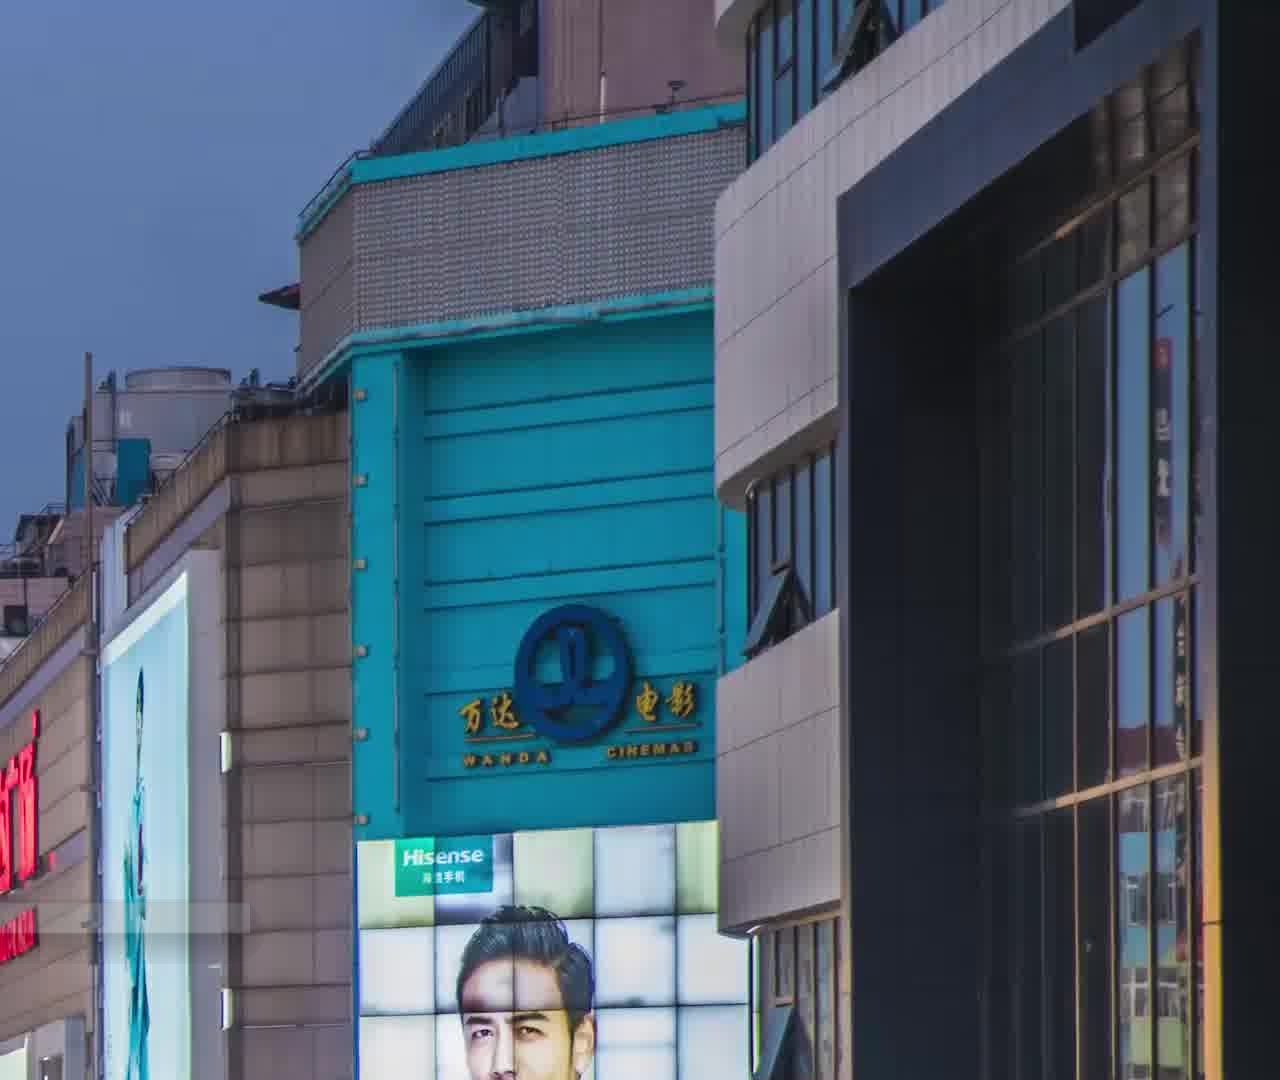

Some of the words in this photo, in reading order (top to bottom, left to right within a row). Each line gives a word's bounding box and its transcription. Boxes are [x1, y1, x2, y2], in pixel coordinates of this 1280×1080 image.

[458, 692, 520, 732] 万达
[635, 681, 699, 722] 电影
[462, 748, 551, 768] WANDA
[606, 741, 699, 760] CINEMAS
[402, 844, 485, 867] Hisense
